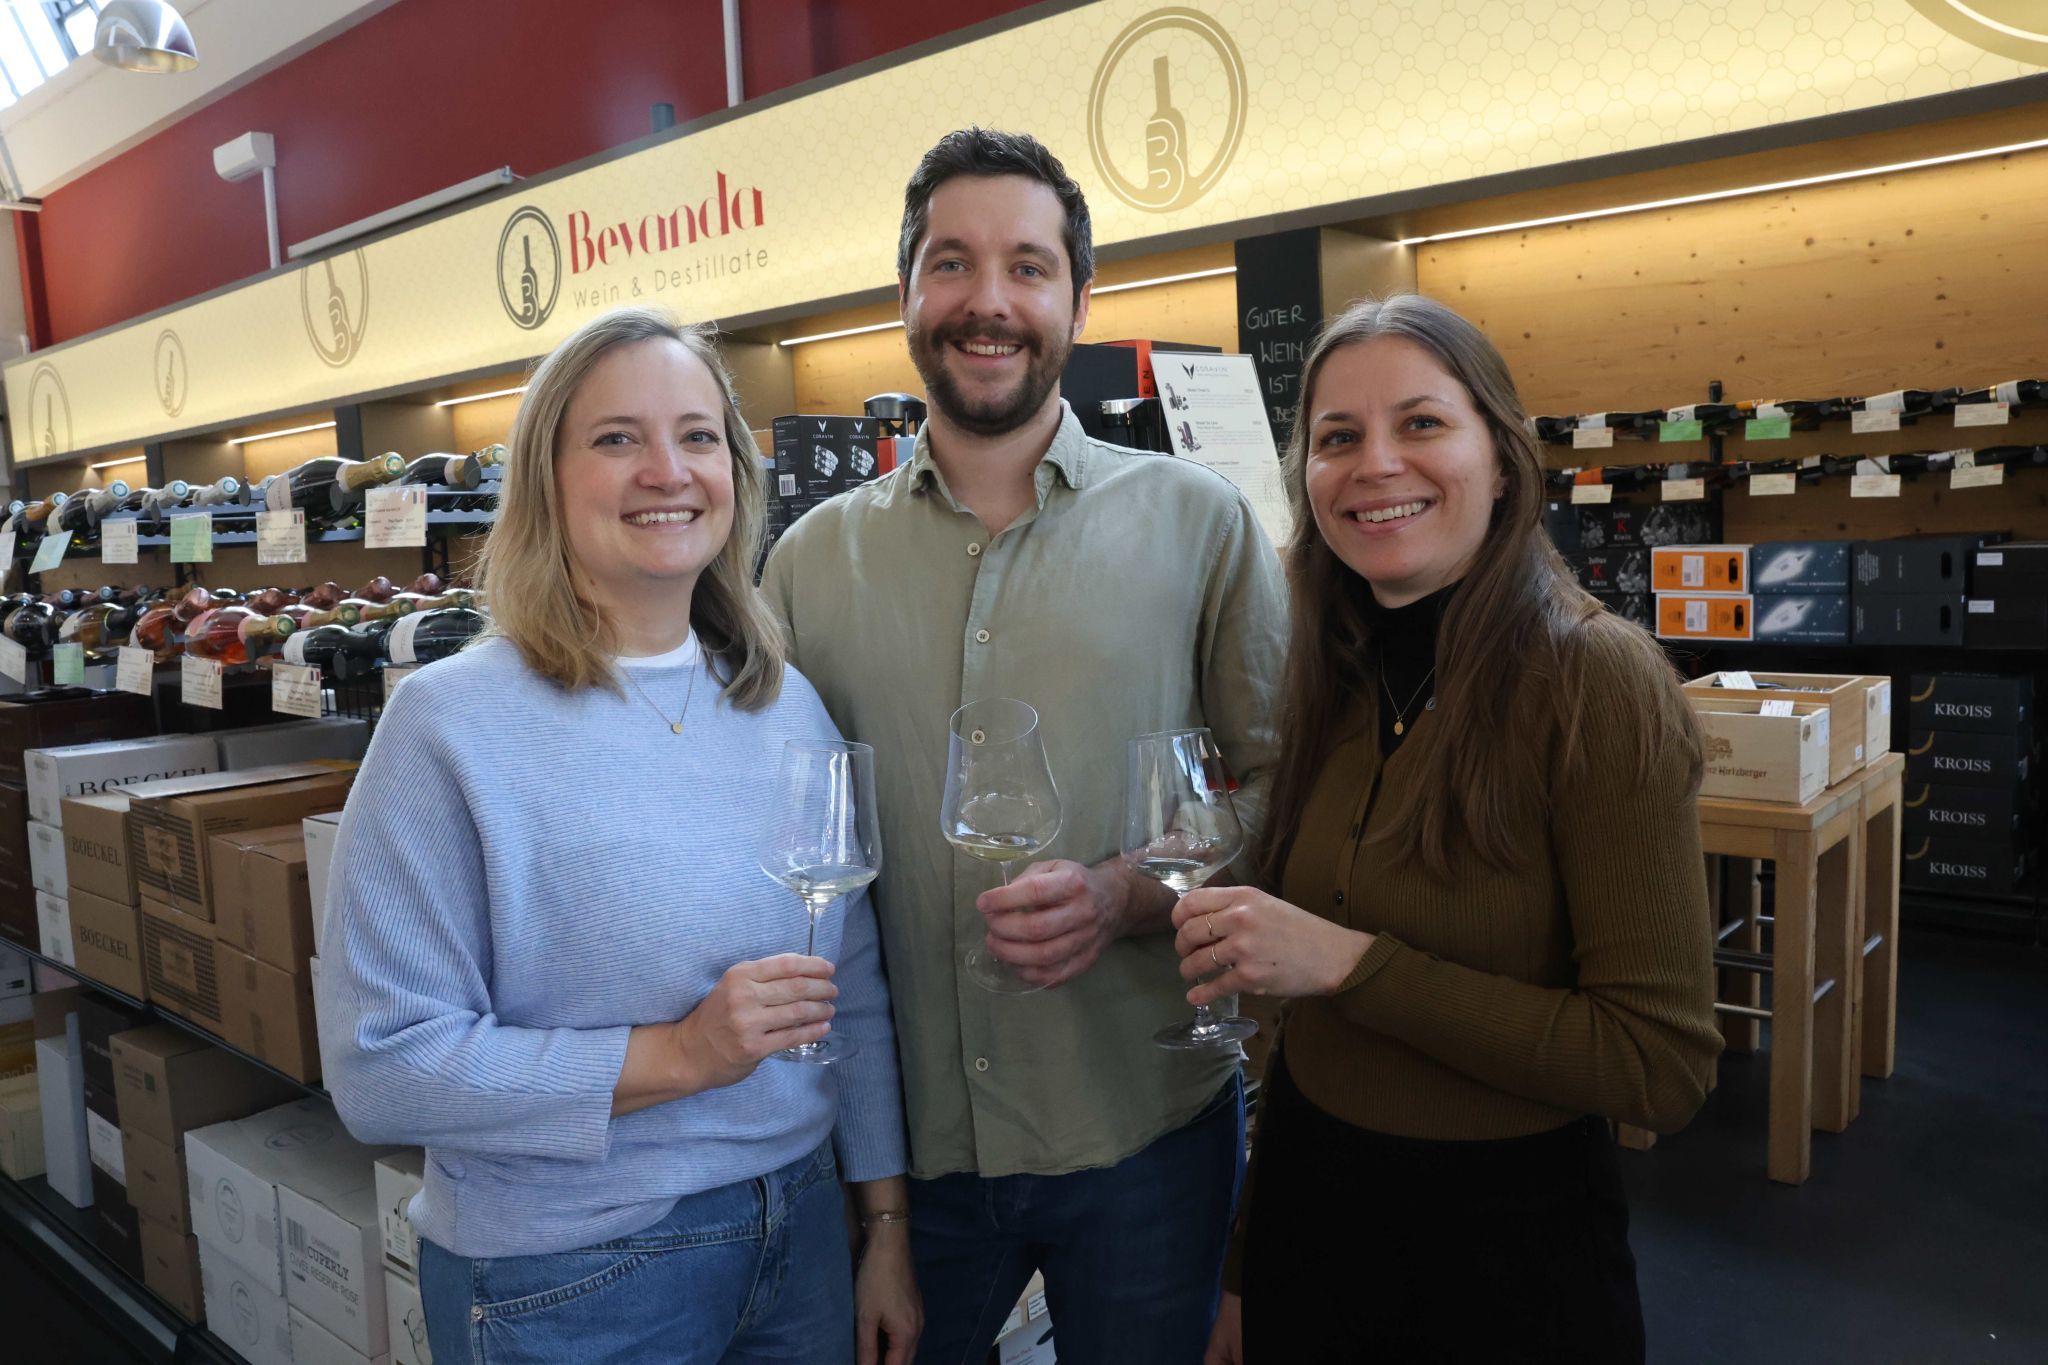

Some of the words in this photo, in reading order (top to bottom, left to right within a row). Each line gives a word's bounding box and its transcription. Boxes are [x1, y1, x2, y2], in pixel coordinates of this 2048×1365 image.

[568, 169, 765, 275] Bevanda
[573, 284, 620, 310] Wein
[631, 276, 643, 297] &
[654, 247, 769, 293] Destillate
[1246, 304, 1306, 329] GUTER
[1260, 340, 1304, 364] WEIN
[1268, 374, 1297, 395] IST
[1934, 703, 1992, 719] KROISS
[1933, 756, 1991, 772] KROISS
[1929, 809, 1986, 826] KROISS
[71, 836, 122, 867] BOECKEL
[1929, 862, 1987, 879] KROISS
[79, 926, 133, 961] BOECKEL
[306, 1246, 349, 1281] CUPERLY
